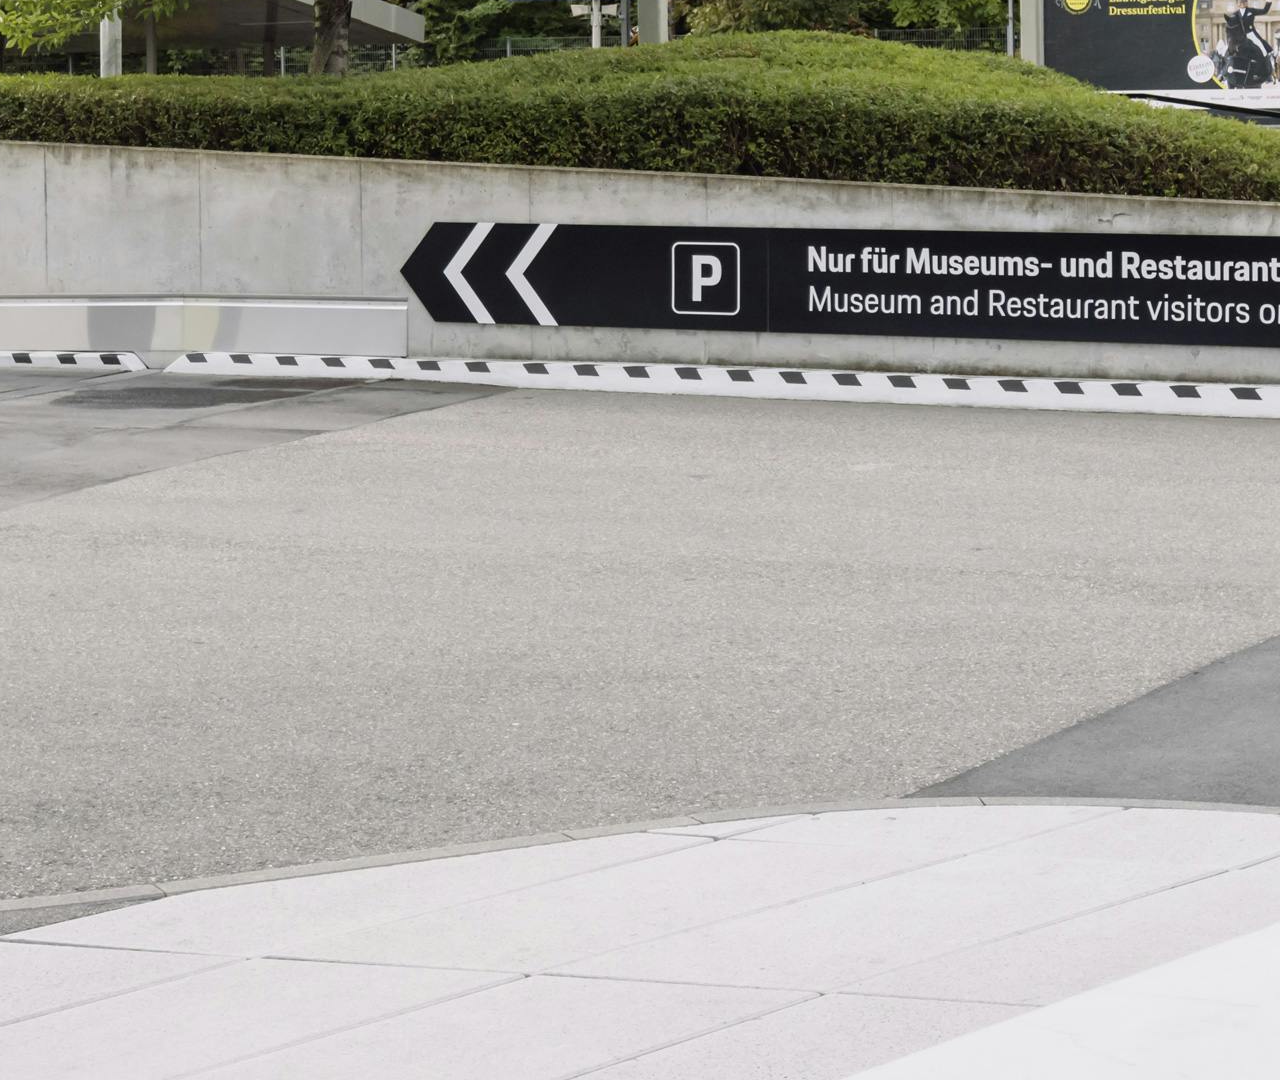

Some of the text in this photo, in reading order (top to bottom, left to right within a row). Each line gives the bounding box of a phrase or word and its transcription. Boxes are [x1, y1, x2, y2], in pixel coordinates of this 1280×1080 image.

[1108, 5, 1186, 16] Dressurfestival
[692, 254, 723, 302] P
[807, 245, 855, 273] Nur
[860, 246, 900, 274] für
[905, 247, 1053, 277] Museums-
[1060, 251, 1113, 278] und
[807, 285, 922, 315] Museum
[929, 289, 979, 317] and
[988, 289, 1140, 321] Restaurant
[1146, 293, 1251, 323] visitors
